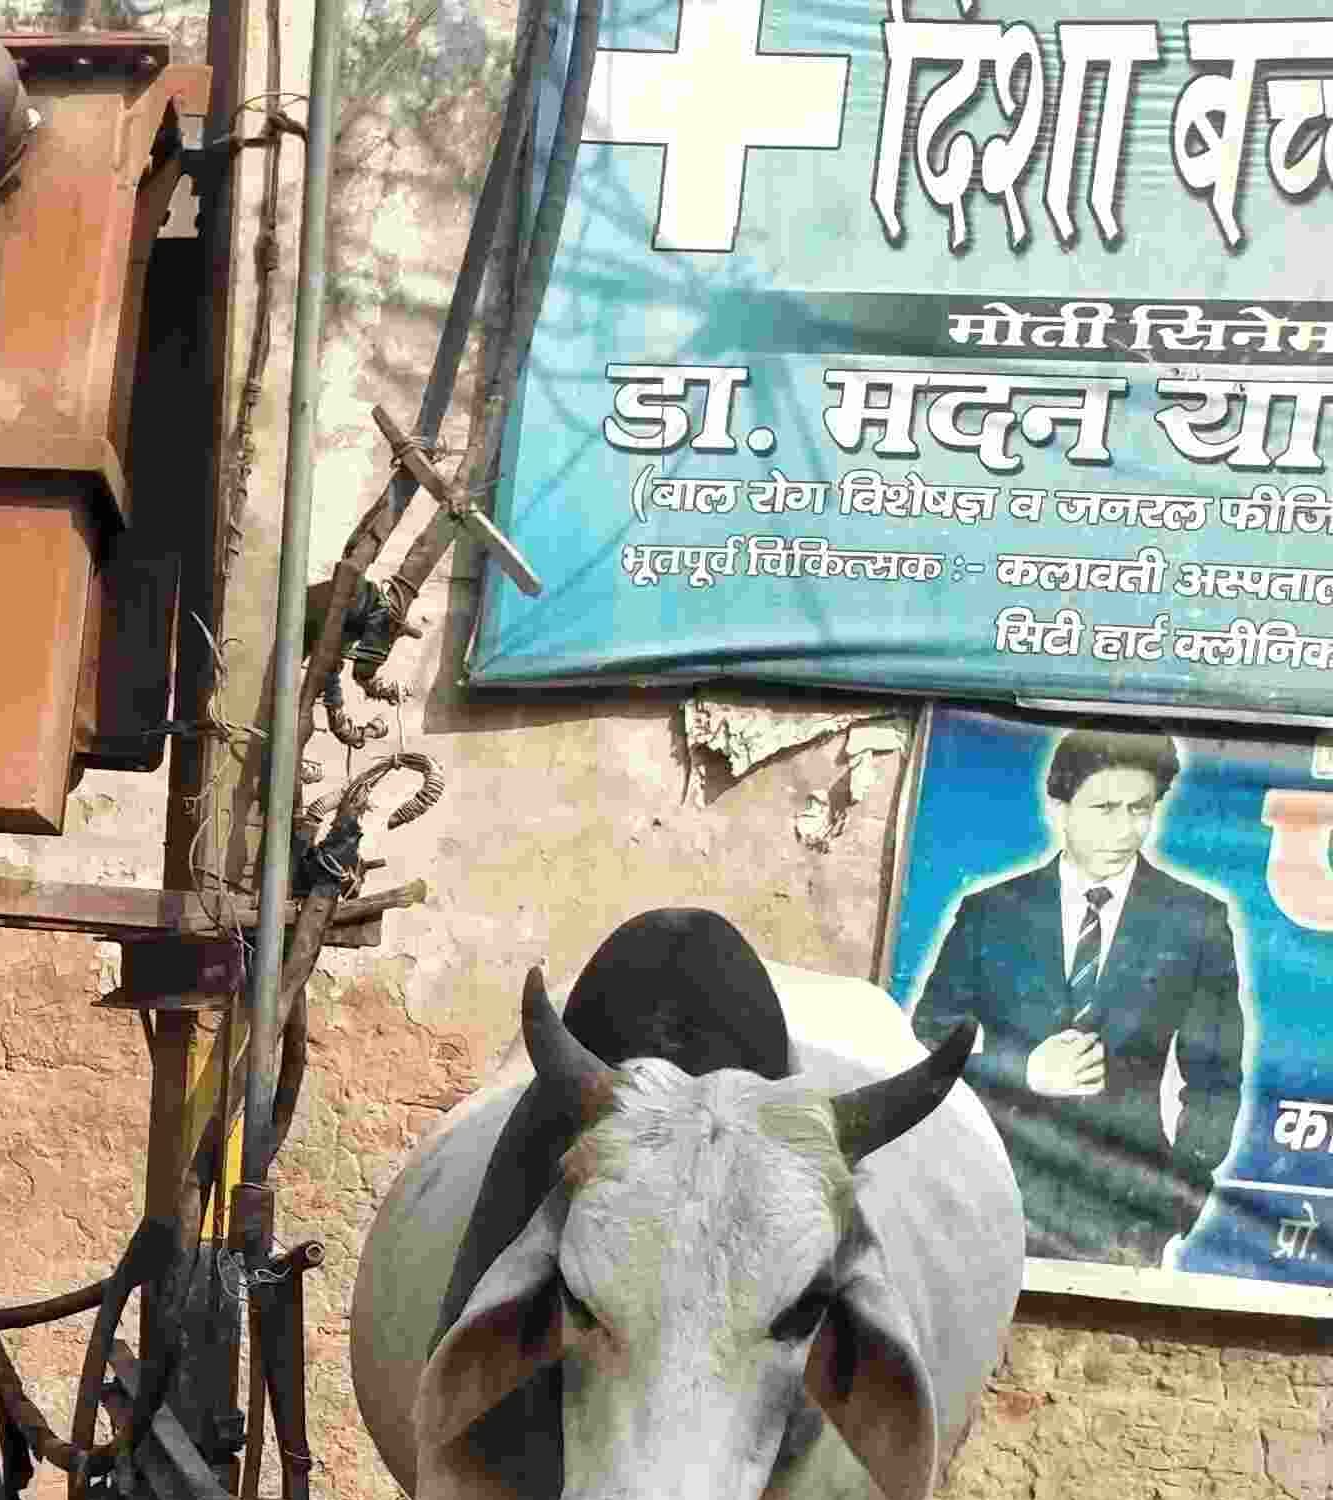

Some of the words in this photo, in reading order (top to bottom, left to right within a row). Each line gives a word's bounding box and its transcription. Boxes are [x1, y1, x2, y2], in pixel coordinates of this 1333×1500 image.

[948, 300, 1116, 349] मोती
[604, 363, 777, 458] डा.
[823, 368, 1129, 474] मदन
[1154, 376, 1333, 474] या
[746, 467, 831, 515] रोग
[837, 468, 1001, 525] विशेषज्ञ
[1008, 487, 1048, 522] व
[1053, 489, 1214, 531] जनरल
[621, 534, 745, 588] भूतपूर्व
[745, 535, 946, 582] चिकित्सक
[996, 546, 1168, 593] कलावती
[995, 606, 1086, 656] सिटी
[1092, 612, 1173, 662] हार्ट
[1270, 1199, 1319, 1263] प्रो.
